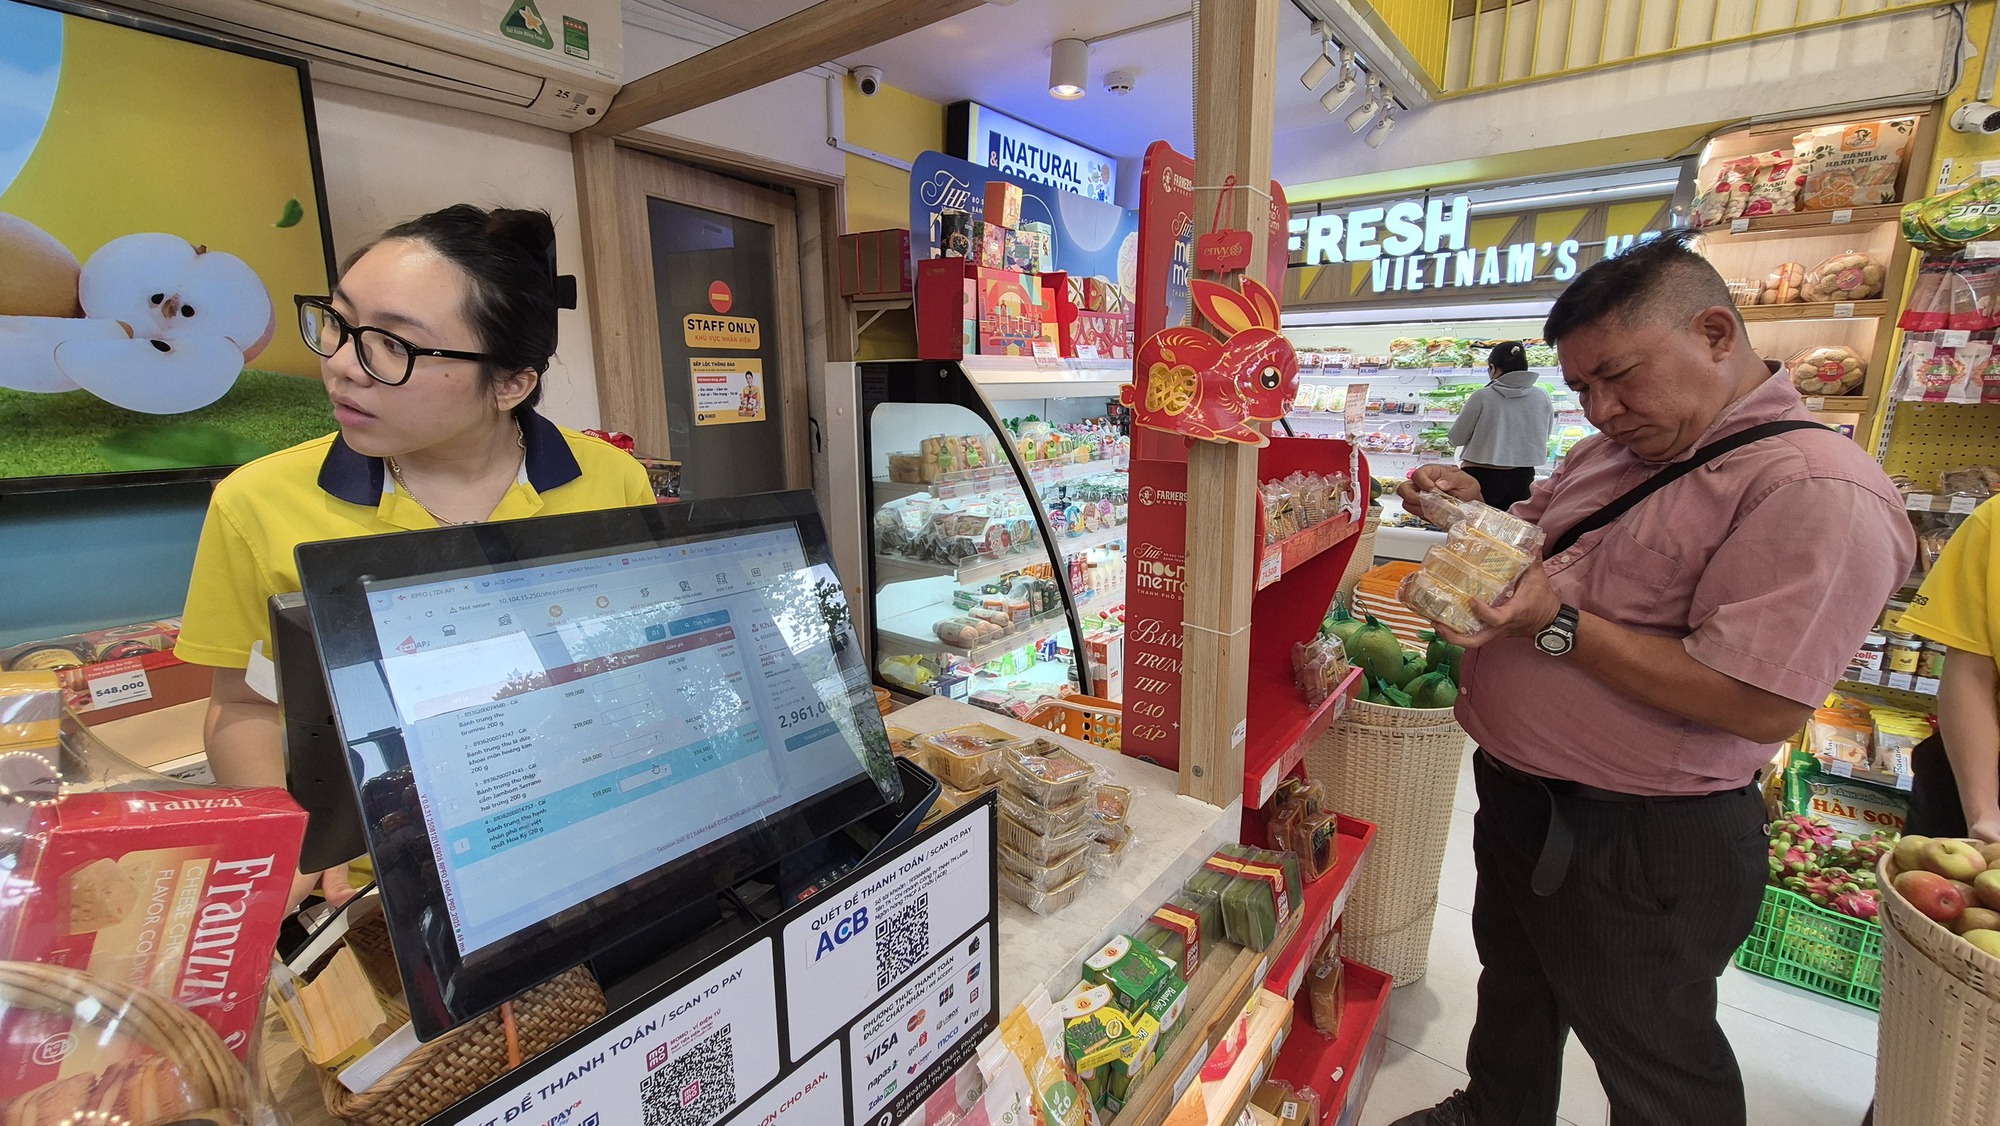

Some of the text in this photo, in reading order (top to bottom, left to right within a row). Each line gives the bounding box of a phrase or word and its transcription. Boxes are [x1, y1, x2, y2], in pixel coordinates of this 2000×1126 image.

[555, 89, 570, 99] 25
[989, 150, 998, 167] &
[1003, 136, 1081, 185] NATURAL
[687, 319, 756, 334] STAFF ONLY
[1157, 490, 1187, 502] FARMERS
[471, 602, 490, 610] secure
[96, 681, 144, 697] 548.000
[1134, 676, 1172, 695] THU
[476, 715, 491, 724] trung
[492, 712, 504, 720] thu
[1132, 700, 1165, 718] CAO
[461, 721, 499, 736] tiramisu 200
[1132, 724, 1167, 741] CẤP
[484, 745, 500, 756] trung
[501, 740, 512, 748] thu
[521, 742, 532, 750] kim
[471, 766, 483, 774] 200
[477, 786, 492, 795] Bánh
[494, 781, 510, 792] trung
[511, 776, 522, 785] thu
[519, 779, 542, 790] Serrano
[481, 803, 491, 812] hai
[510, 794, 521, 802] 200
[1813, 798, 1858, 820] HẢI
[487, 824, 503, 834] Bánh
[506, 836, 519, 845] Hoa
[657, 840, 676, 852] Session
[811, 902, 842, 931] QUÉT
[861, 872, 897, 897] THANH
[898, 853, 925, 876] TOÁN
[930, 839, 949, 857] SCAN
[949, 834, 958, 844] TO
[959, 825, 972, 839] PAY
[143, 869, 175, 926] FLAVOR
[175, 866, 203, 919] CHEESE
[457, 933, 464, 942] 49
[815, 905, 869, 962] ACB
[863, 1003, 894, 1032] PHƯƠNG
[895, 987, 914, 1006] THỨC
[914, 970, 937, 989] THANH
[937, 955, 954, 973] TOÁN
[863, 1021, 885, 1041] ĐƯỢC
[906, 988, 925, 1007] NHẬN
[936, 966, 953, 982] ACCEPT
[969, 1008, 981, 1021] Pay
[504, 1092, 533, 1123] ĐỂ
[537, 1052, 605, 1101] THANH
[608, 1018, 657, 1057] TOÁN
[668, 995, 702, 1021] SCAN
[703, 983, 720, 1001] TO
[721, 968, 743, 989] PAY
[938, 1026, 959, 1050] moca
[864, 1032, 899, 1066] VISA
[867, 1065, 892, 1091] napas
[896, 1100, 915, 1118] Quận
[915, 1084, 931, 1101] Bình
[962, 1040, 977, 1057] HCM
[780, 1072, 828, 1113] CHO BẠN,
[895, 1097, 905, 1110] 99
[905, 1078, 927, 1099] Hoàng
[928, 1065, 941, 1080] Hoa
